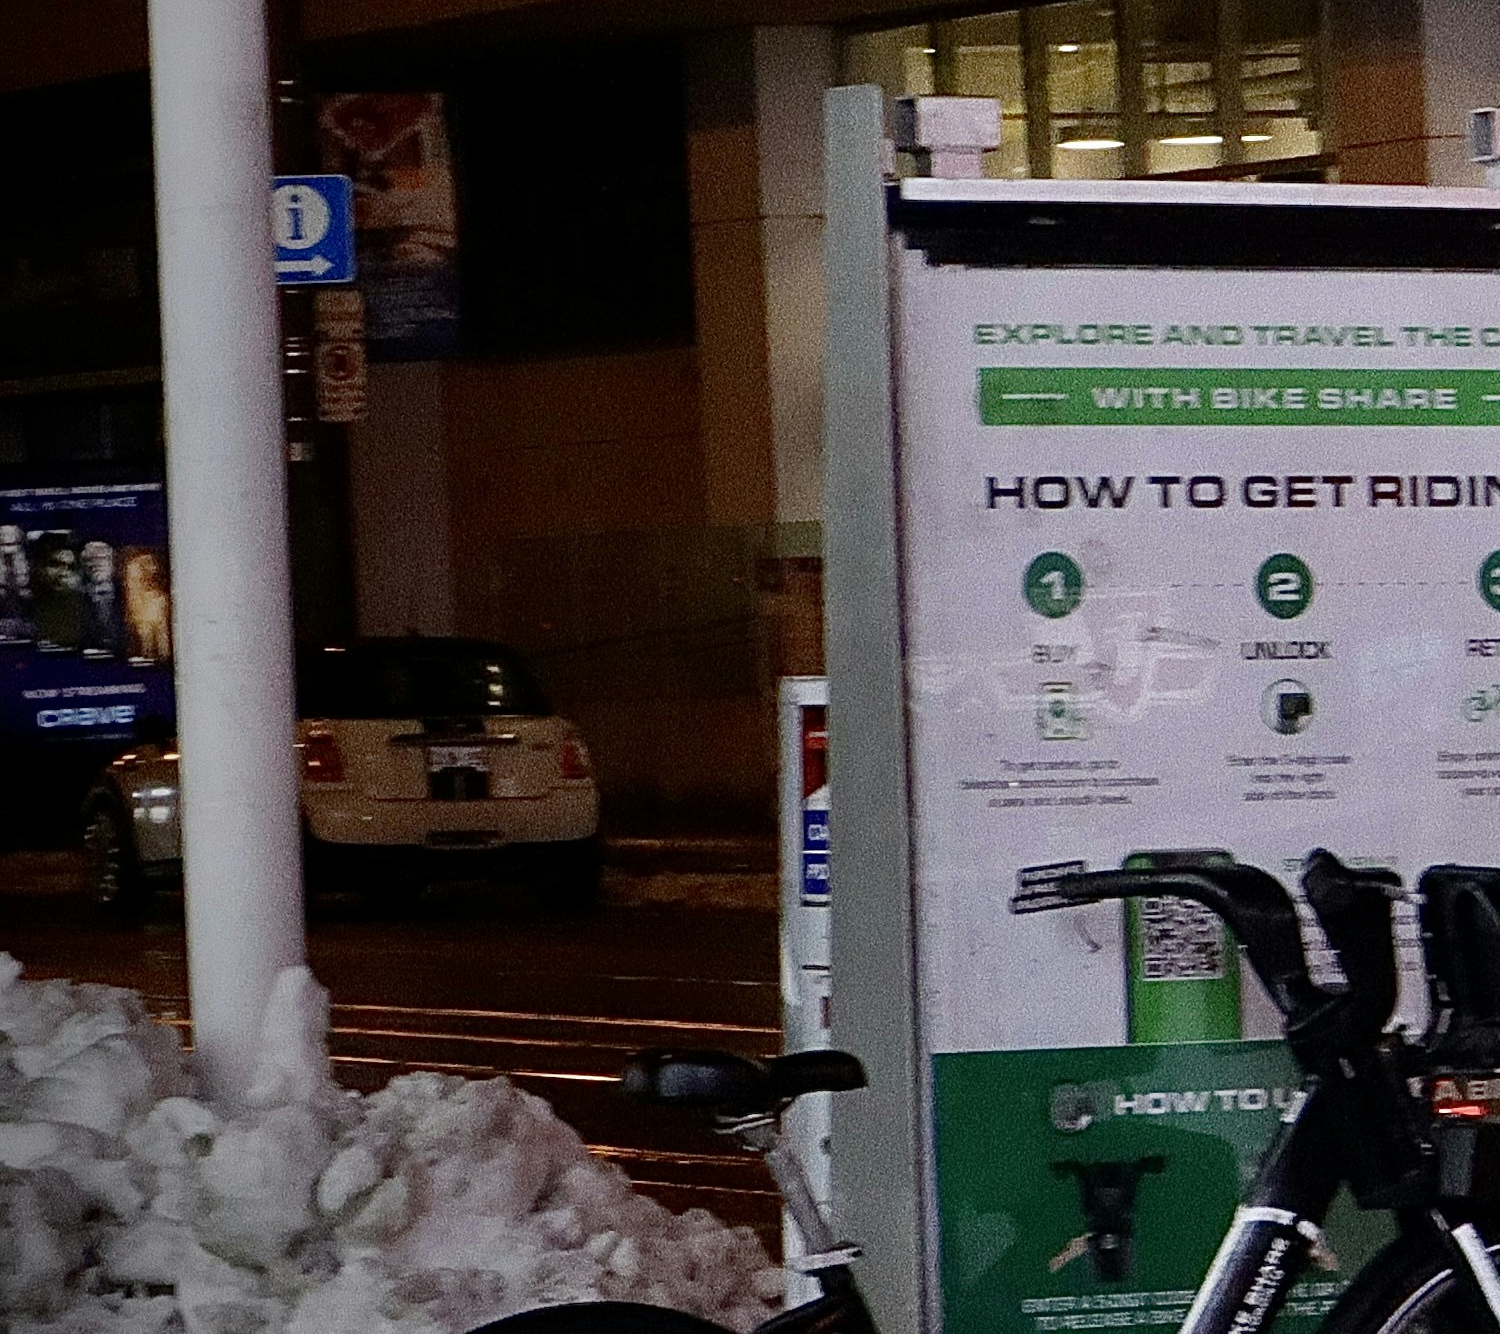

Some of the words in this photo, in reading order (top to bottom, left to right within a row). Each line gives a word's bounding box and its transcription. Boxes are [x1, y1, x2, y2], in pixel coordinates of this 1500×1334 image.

[974, 323, 1154, 347] EXPLORE
[1163, 323, 1243, 347] AND
[1252, 323, 1394, 348] TRAVEL
[1400, 325, 1472, 348] THE
[1091, 387, 1199, 410] WITH
[1210, 387, 1308, 410] BIKE
[1317, 387, 1459, 411] SHARE
[985, 475, 1136, 510] HOW
[1146, 475, 1227, 509] TO
[1241, 474, 1355, 509] GET
[1038, 570, 1066, 601] 1
[1267, 571, 1302, 601] 2
[1240, 640, 1336, 661] UNLOCK
[1113, 1090, 1210, 1117] HOW
[1214, 1087, 1269, 1114] TO
[1435, 1077, 1467, 1102] A
